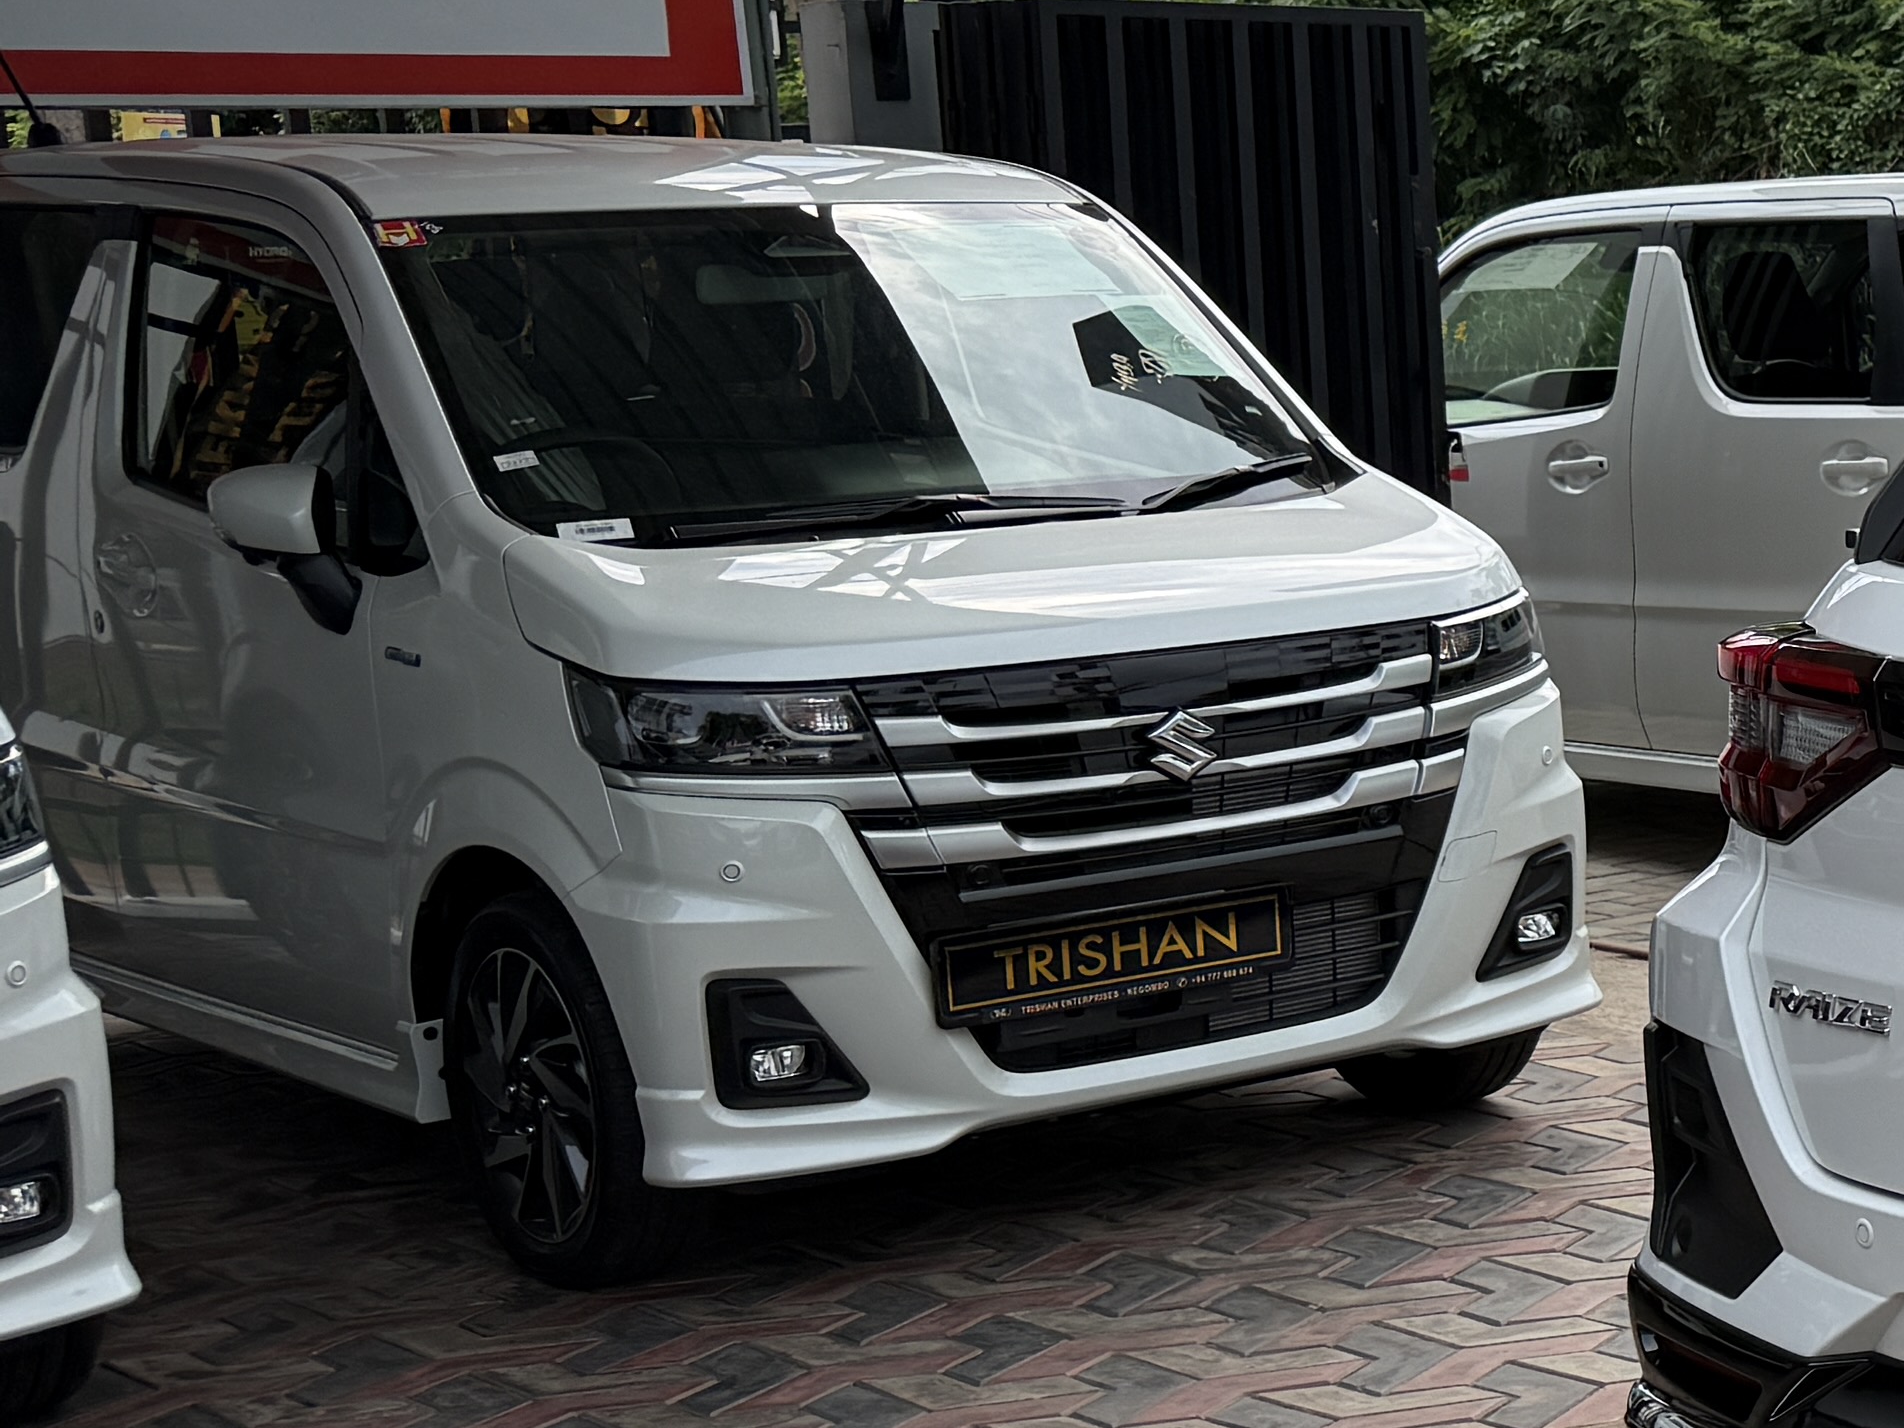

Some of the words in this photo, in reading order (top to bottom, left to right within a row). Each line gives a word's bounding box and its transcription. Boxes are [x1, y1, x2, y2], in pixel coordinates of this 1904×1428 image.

[993, 911, 1238, 990] TRISHAN
[1021, 1001, 1059, 1015] TRISHAN
[1061, 990, 1120, 1009] ENTERPRISES
[1769, 980, 1892, 1036] RAIZE
